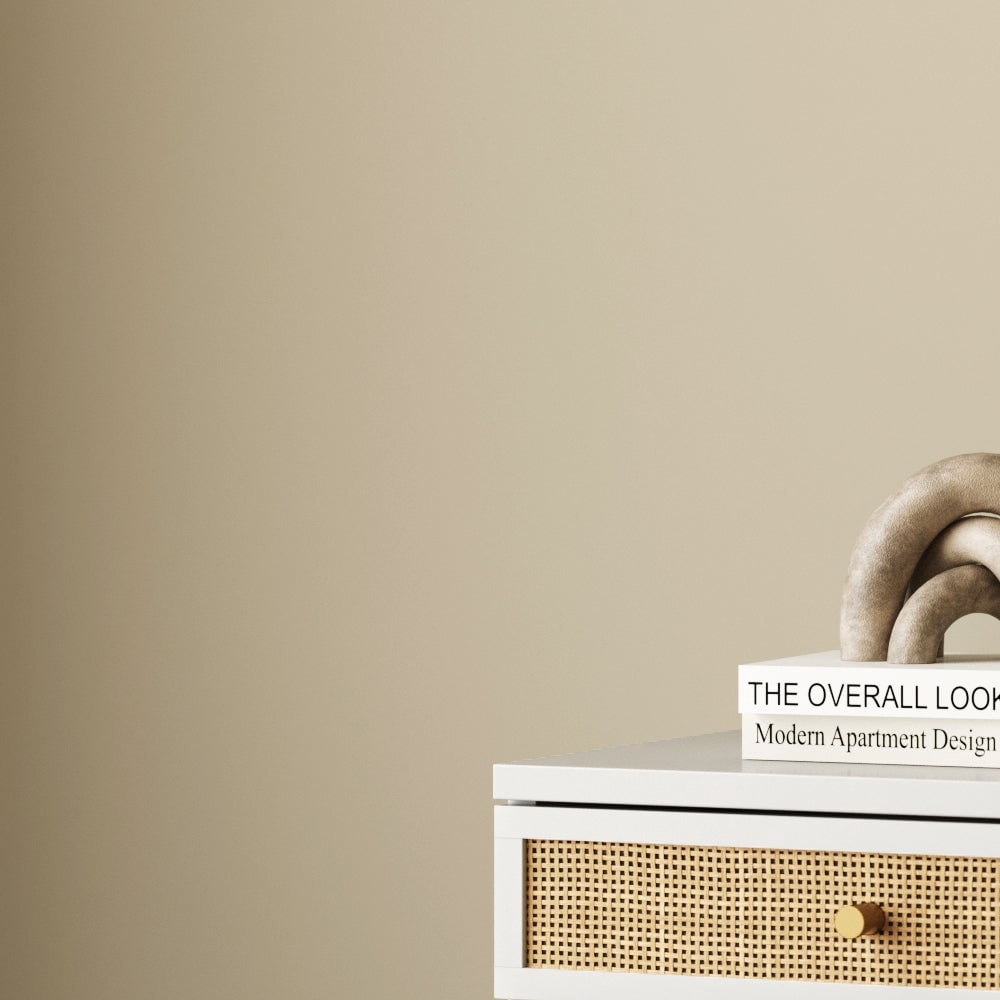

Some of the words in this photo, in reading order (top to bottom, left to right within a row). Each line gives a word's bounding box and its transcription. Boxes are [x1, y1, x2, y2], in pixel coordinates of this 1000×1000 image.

[747, 682, 798, 705] THE
[807, 683, 927, 709] OVERALL
[755, 723, 824, 745] Modern
[830, 726, 926, 752] Apartment
[933, 729, 995, 757] Design
